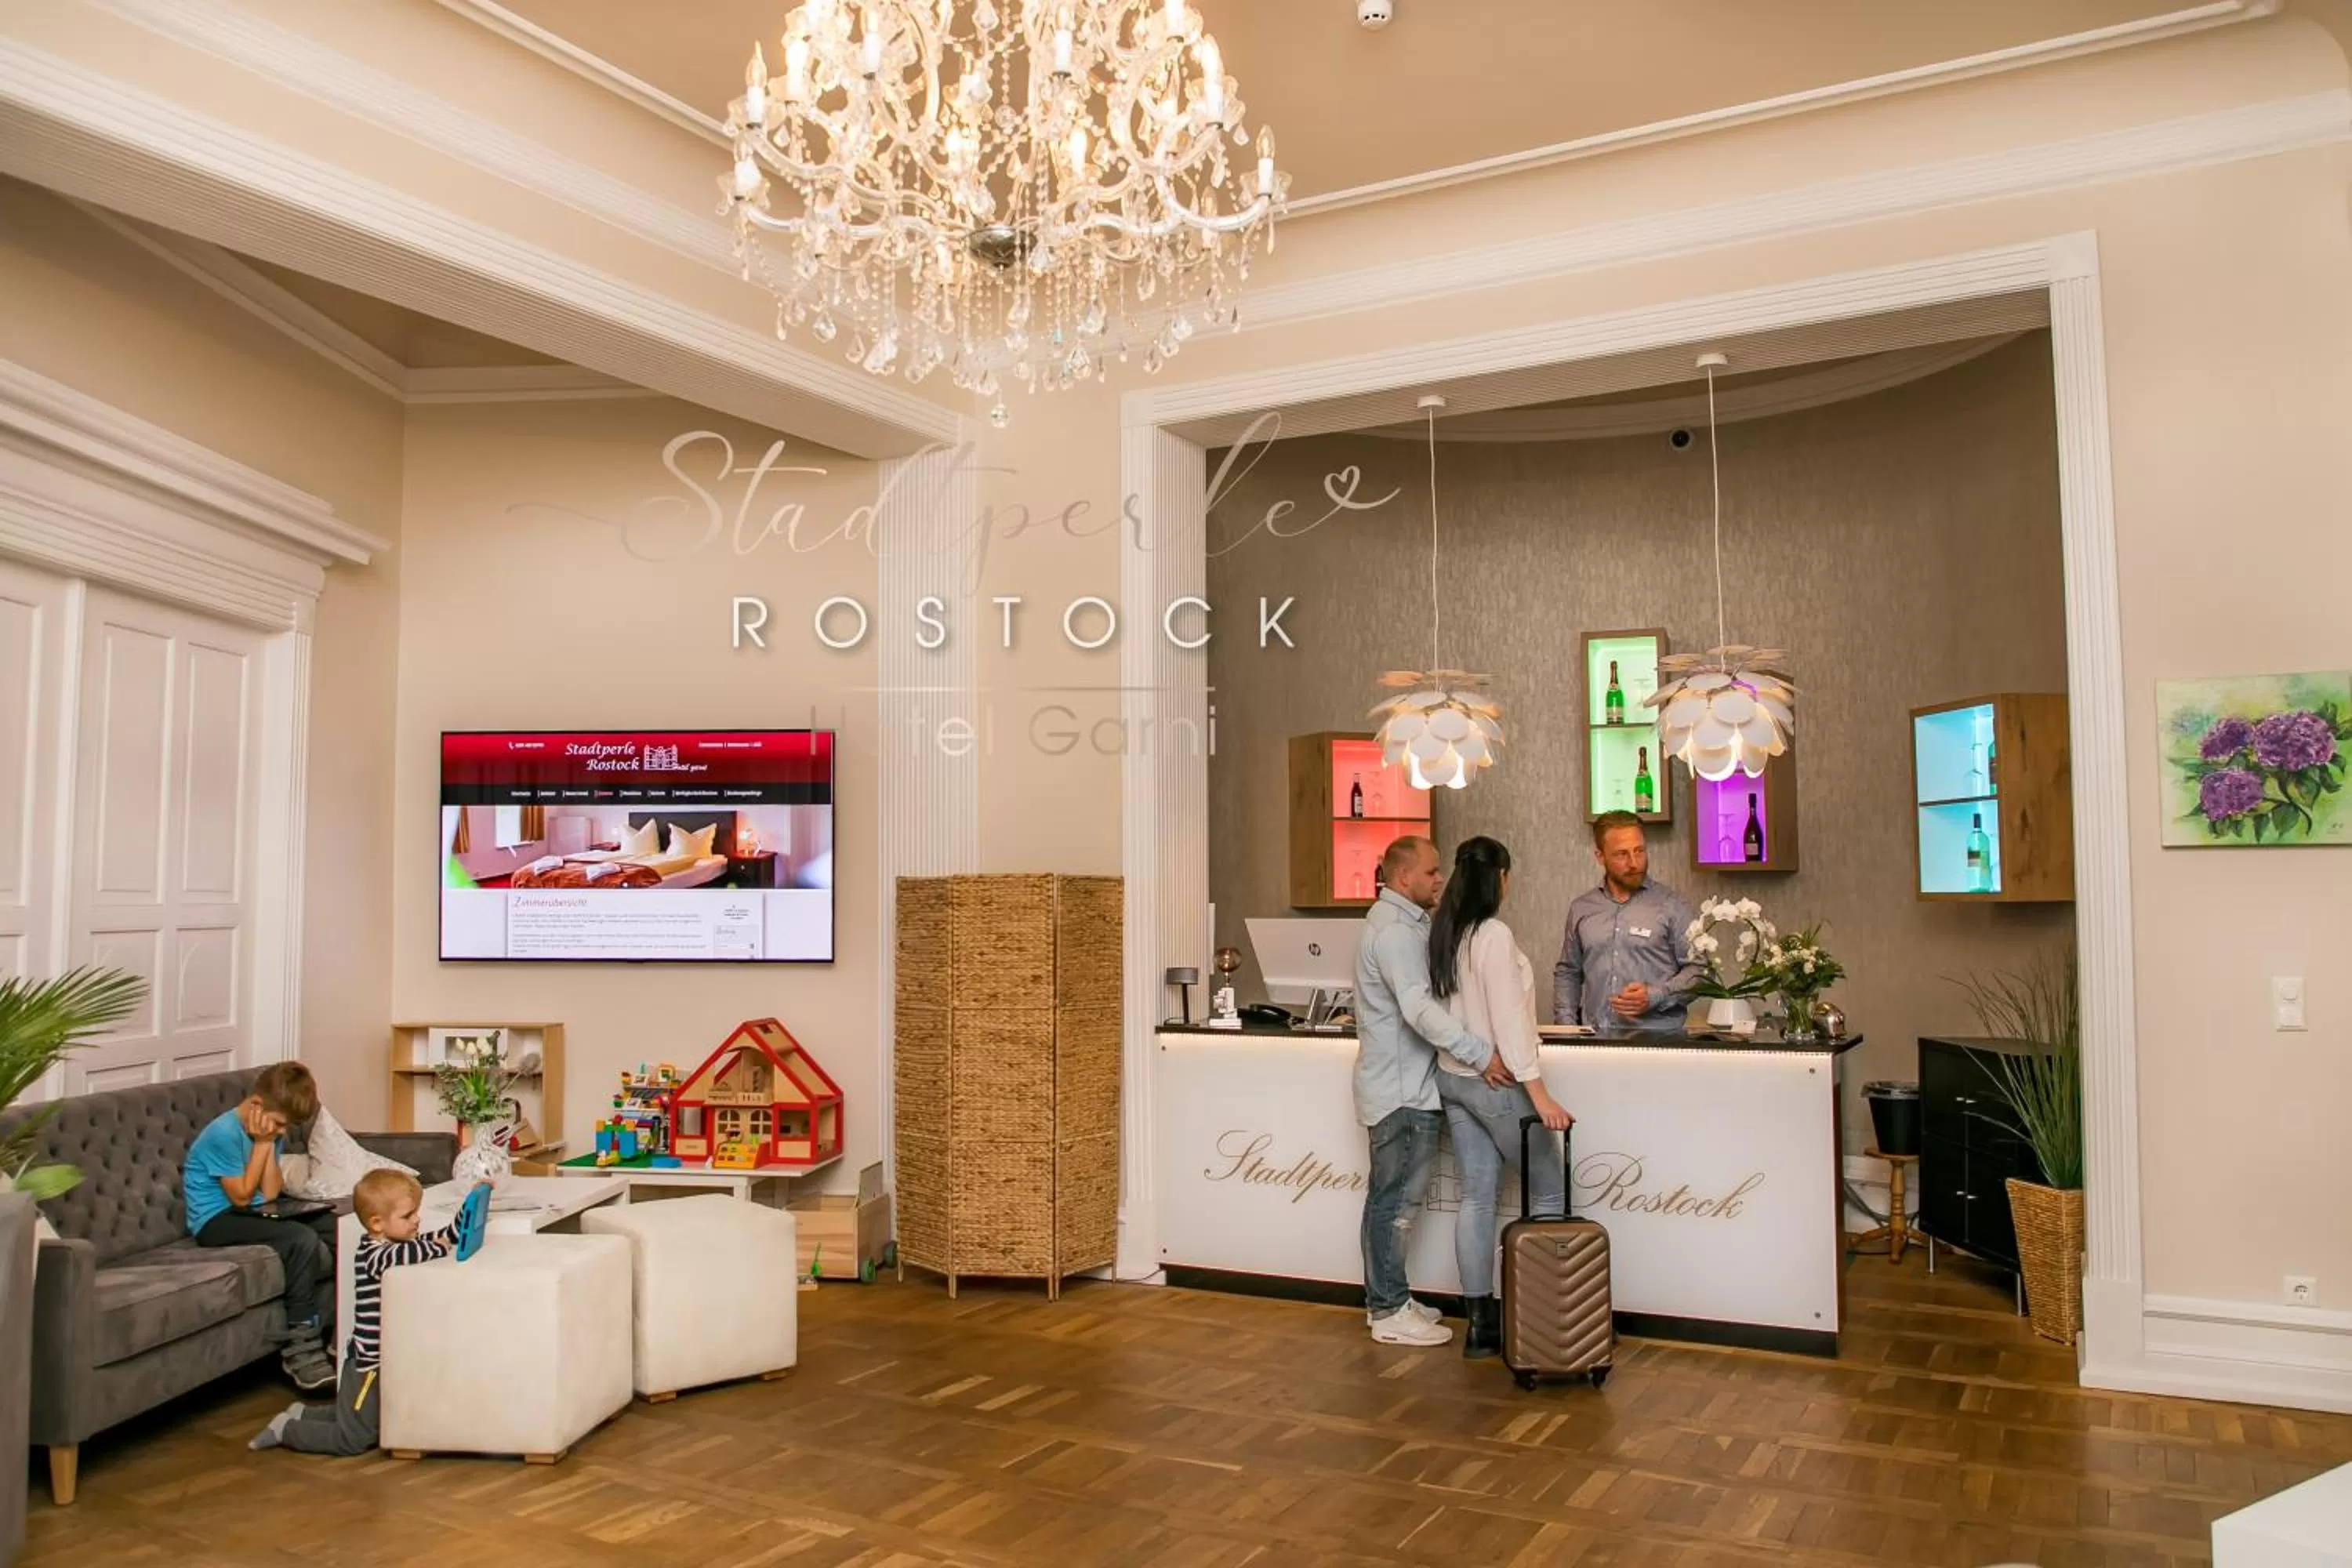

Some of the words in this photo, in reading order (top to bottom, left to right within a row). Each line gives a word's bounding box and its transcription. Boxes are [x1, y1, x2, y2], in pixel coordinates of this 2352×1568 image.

[564, 741, 637, 759] Stadtperle
[586, 757, 641, 771] Rostock
[1203, 1130, 1368, 1203] Stadtper
[1569, 1152, 1766, 1218] Rostock
